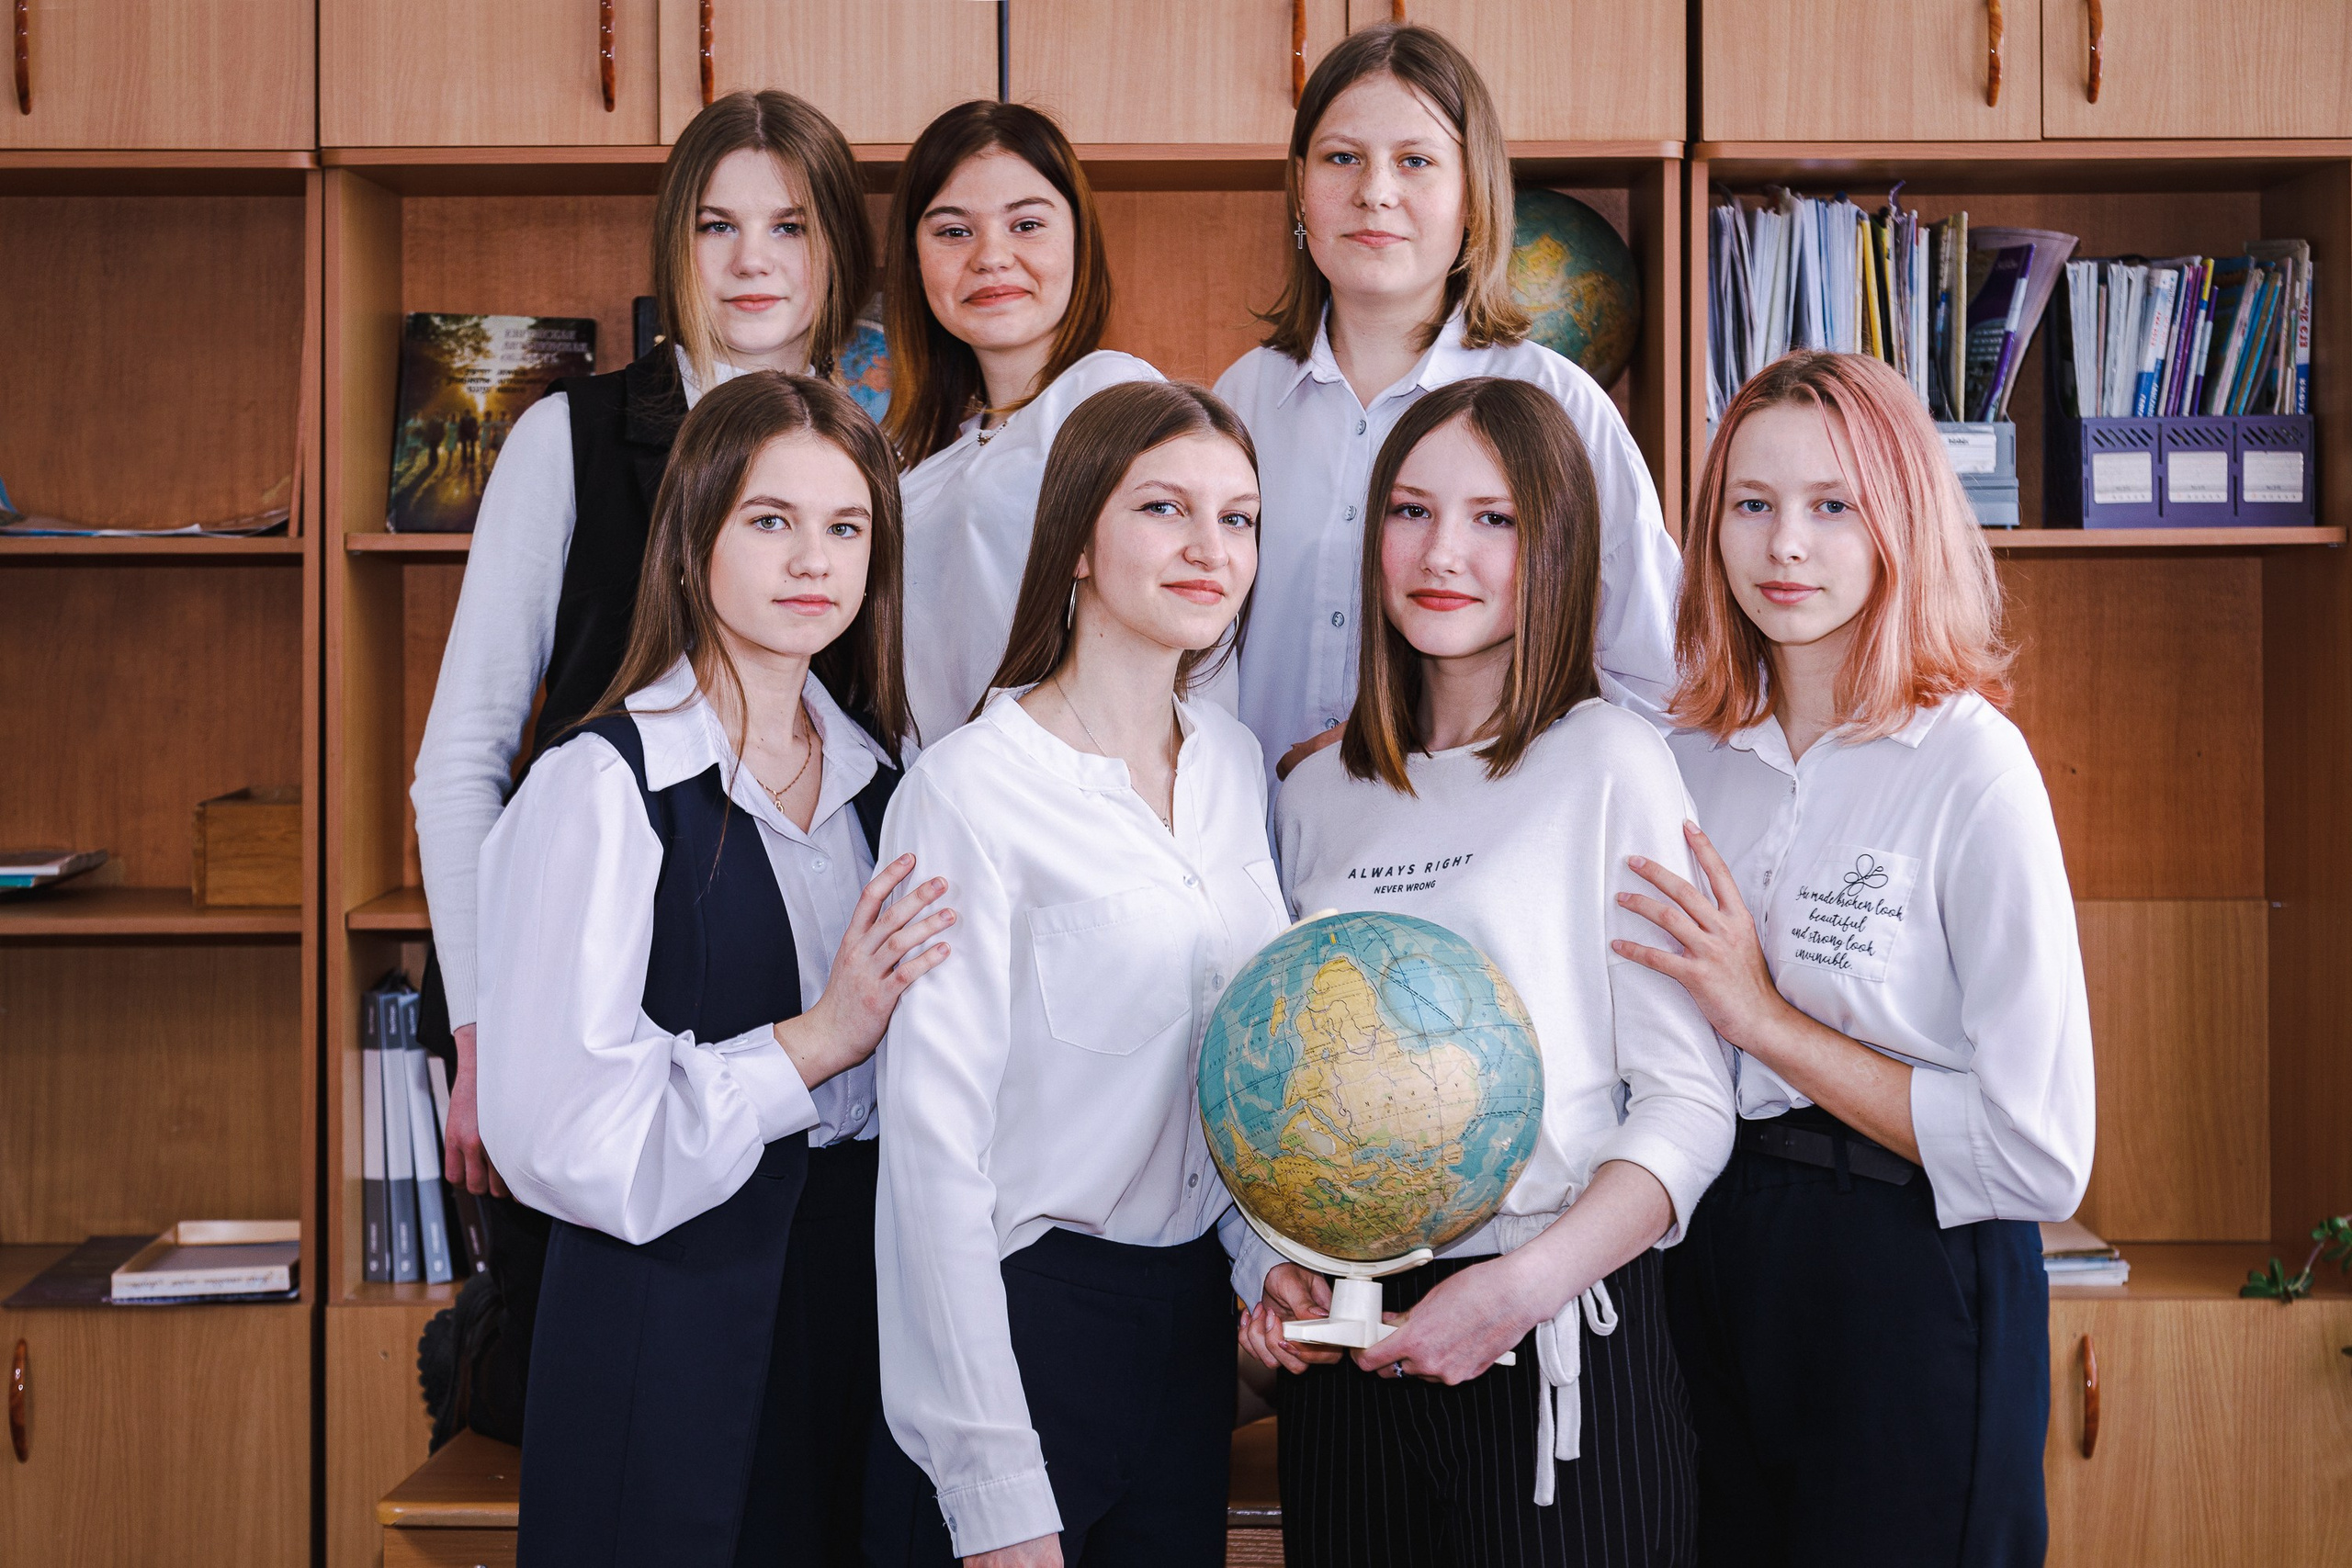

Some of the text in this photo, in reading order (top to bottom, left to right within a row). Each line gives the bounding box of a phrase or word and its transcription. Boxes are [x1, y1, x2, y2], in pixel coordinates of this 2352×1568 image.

[2299, 325, 2309, 348] ЕГЭ
[1348, 853, 1474, 879] ALWAYS RIGHT
[1374, 880, 1437, 895] NEVER WRONG
[1795, 886, 1905, 922] She made broken look
[1808, 908, 1868, 933] beautiful
[1792, 926, 1876, 956] and strong look
